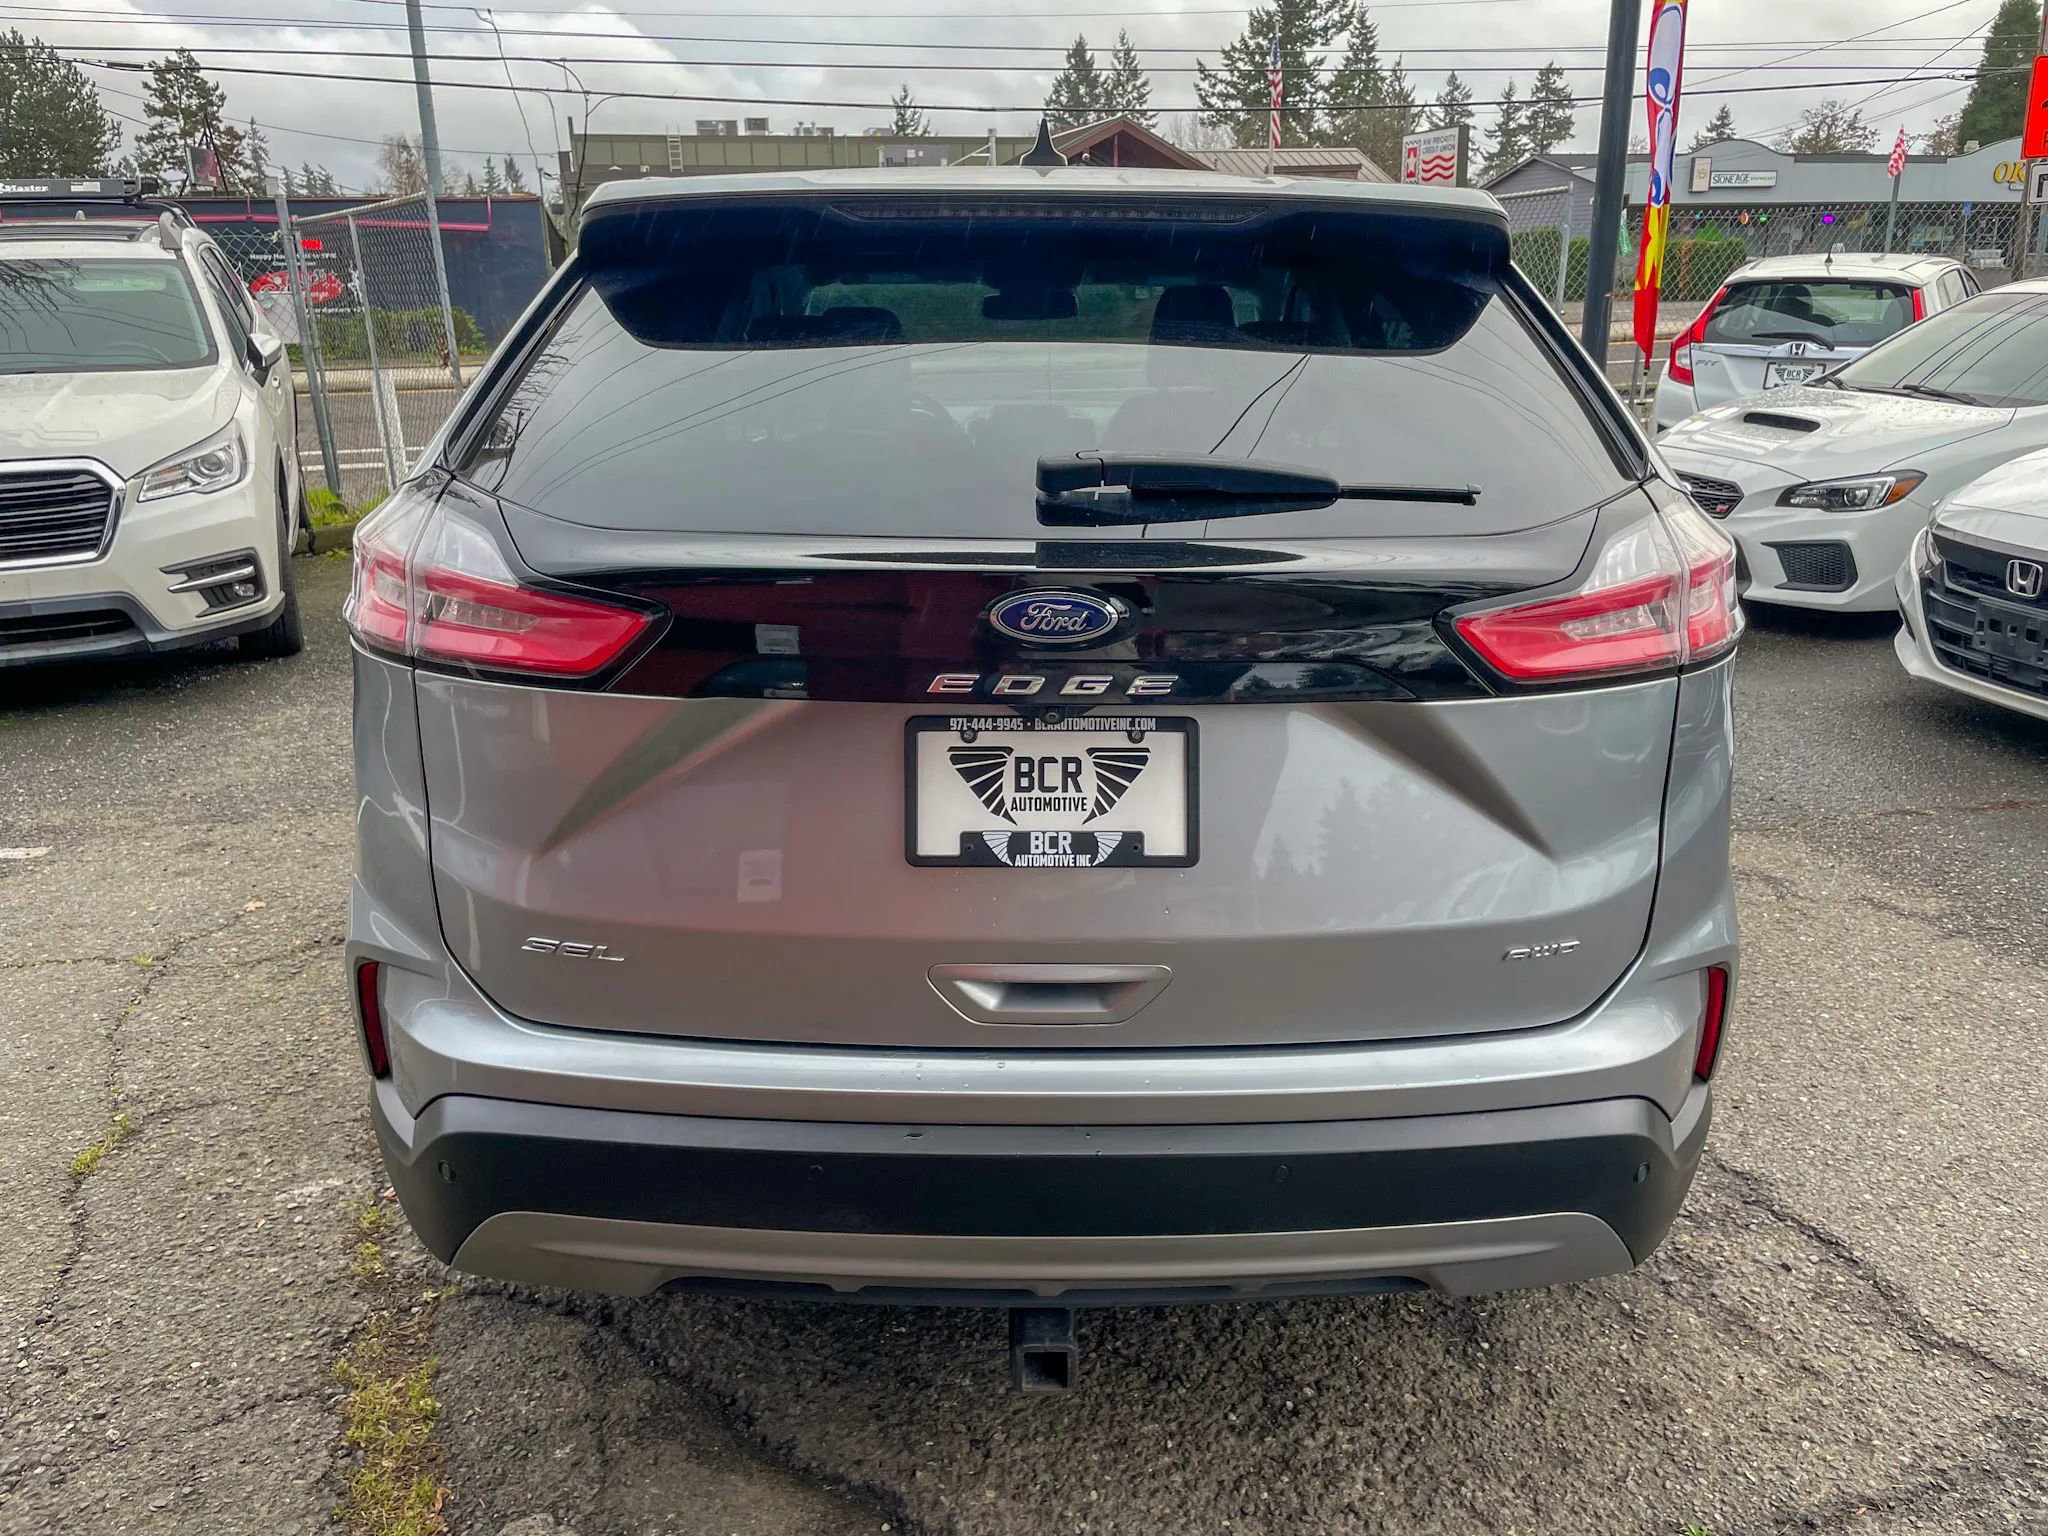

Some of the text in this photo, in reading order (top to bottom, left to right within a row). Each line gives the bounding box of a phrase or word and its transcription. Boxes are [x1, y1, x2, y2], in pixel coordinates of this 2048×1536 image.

[1712, 173, 1735, 184] STONE
[1735, 173, 1750, 183] AGE
[1786, 369, 1801, 378] BCR
[1020, 602, 1089, 631] Ford
[926, 672, 1179, 695] EDGE
[949, 718, 1024, 731] 971-444-9945
[1013, 756, 1083, 794] BCR
[1010, 797, 1088, 812] AUTOMOTIVE
[1029, 831, 1072, 854] BCR
[1014, 855, 1092, 867] AUTOMOTIVE INC
[521, 936, 625, 962] SEL
